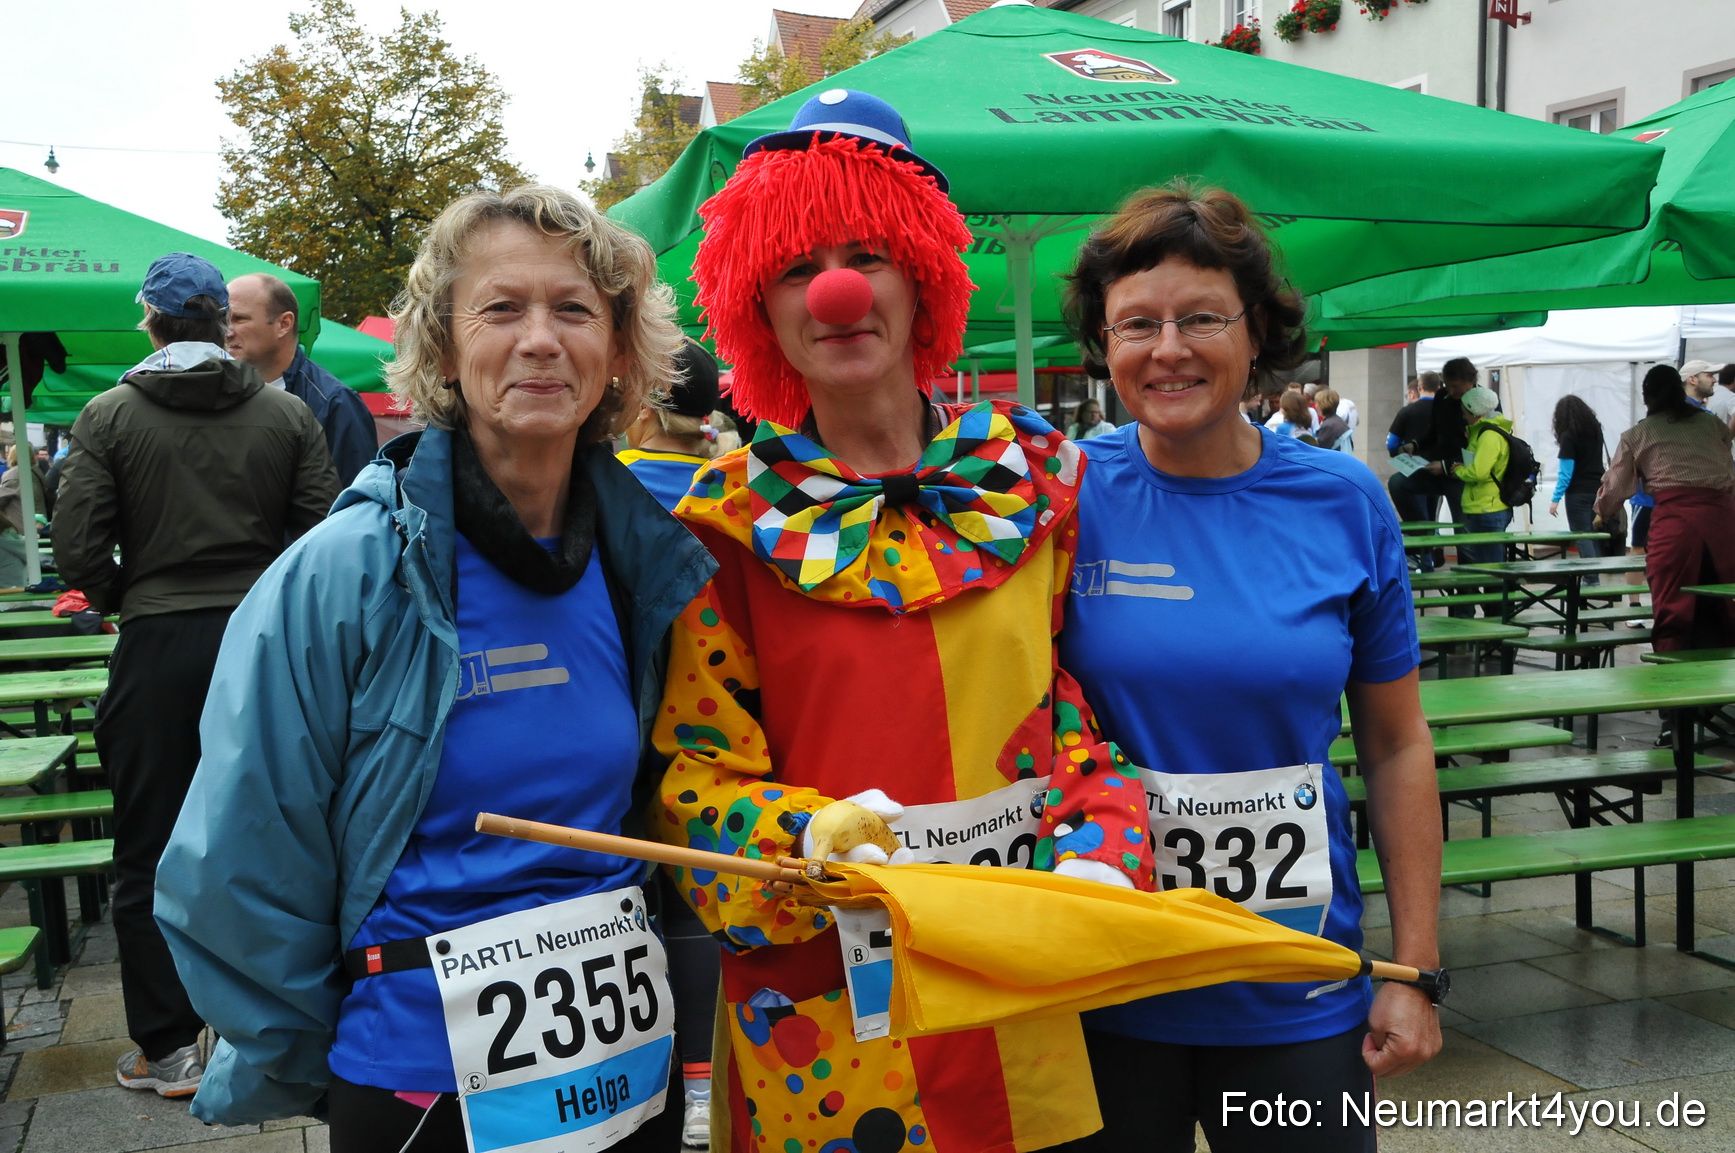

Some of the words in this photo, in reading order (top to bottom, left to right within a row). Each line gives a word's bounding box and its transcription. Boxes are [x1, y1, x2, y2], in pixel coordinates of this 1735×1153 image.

[985, 105, 1380, 133] Lammsbräu
[1022, 90, 1294, 113] Neumarkter
[1177, 792, 1286, 816] Neumarkt
[926, 805, 1023, 848] Neumarkt
[1150, 822, 1308, 903] 332
[440, 938, 533, 979] PARTL
[536, 915, 634, 954] Neumarkt
[854, 948, 864, 962] B
[476, 944, 659, 1075] 2355
[555, 1073, 630, 1123] Helga
